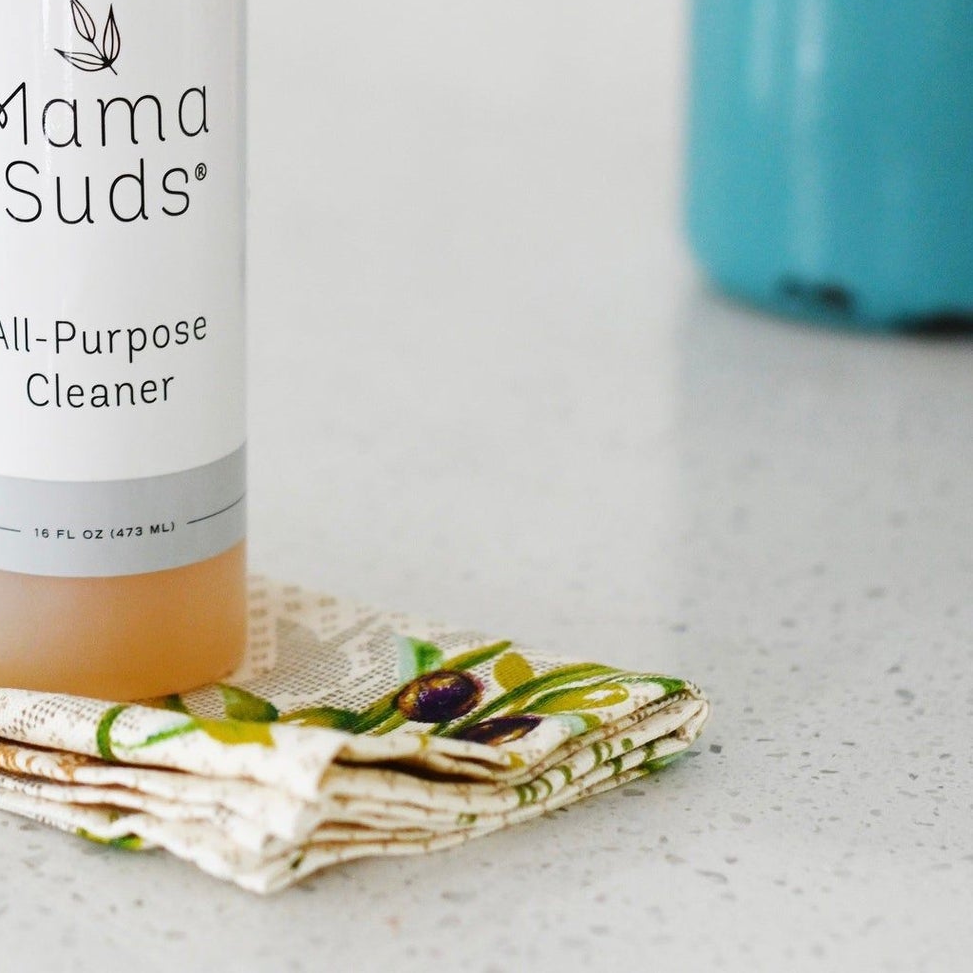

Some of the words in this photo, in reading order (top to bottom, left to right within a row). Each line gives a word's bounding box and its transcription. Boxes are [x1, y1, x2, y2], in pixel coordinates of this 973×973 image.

[26, 372, 175, 409] Cleaner
[33, 527, 50, 539] 16
[56, 529, 76, 540] FL
[82, 529, 104, 540] OZ
[110, 526, 143, 540] (473
[149, 521, 176, 535] ML)
